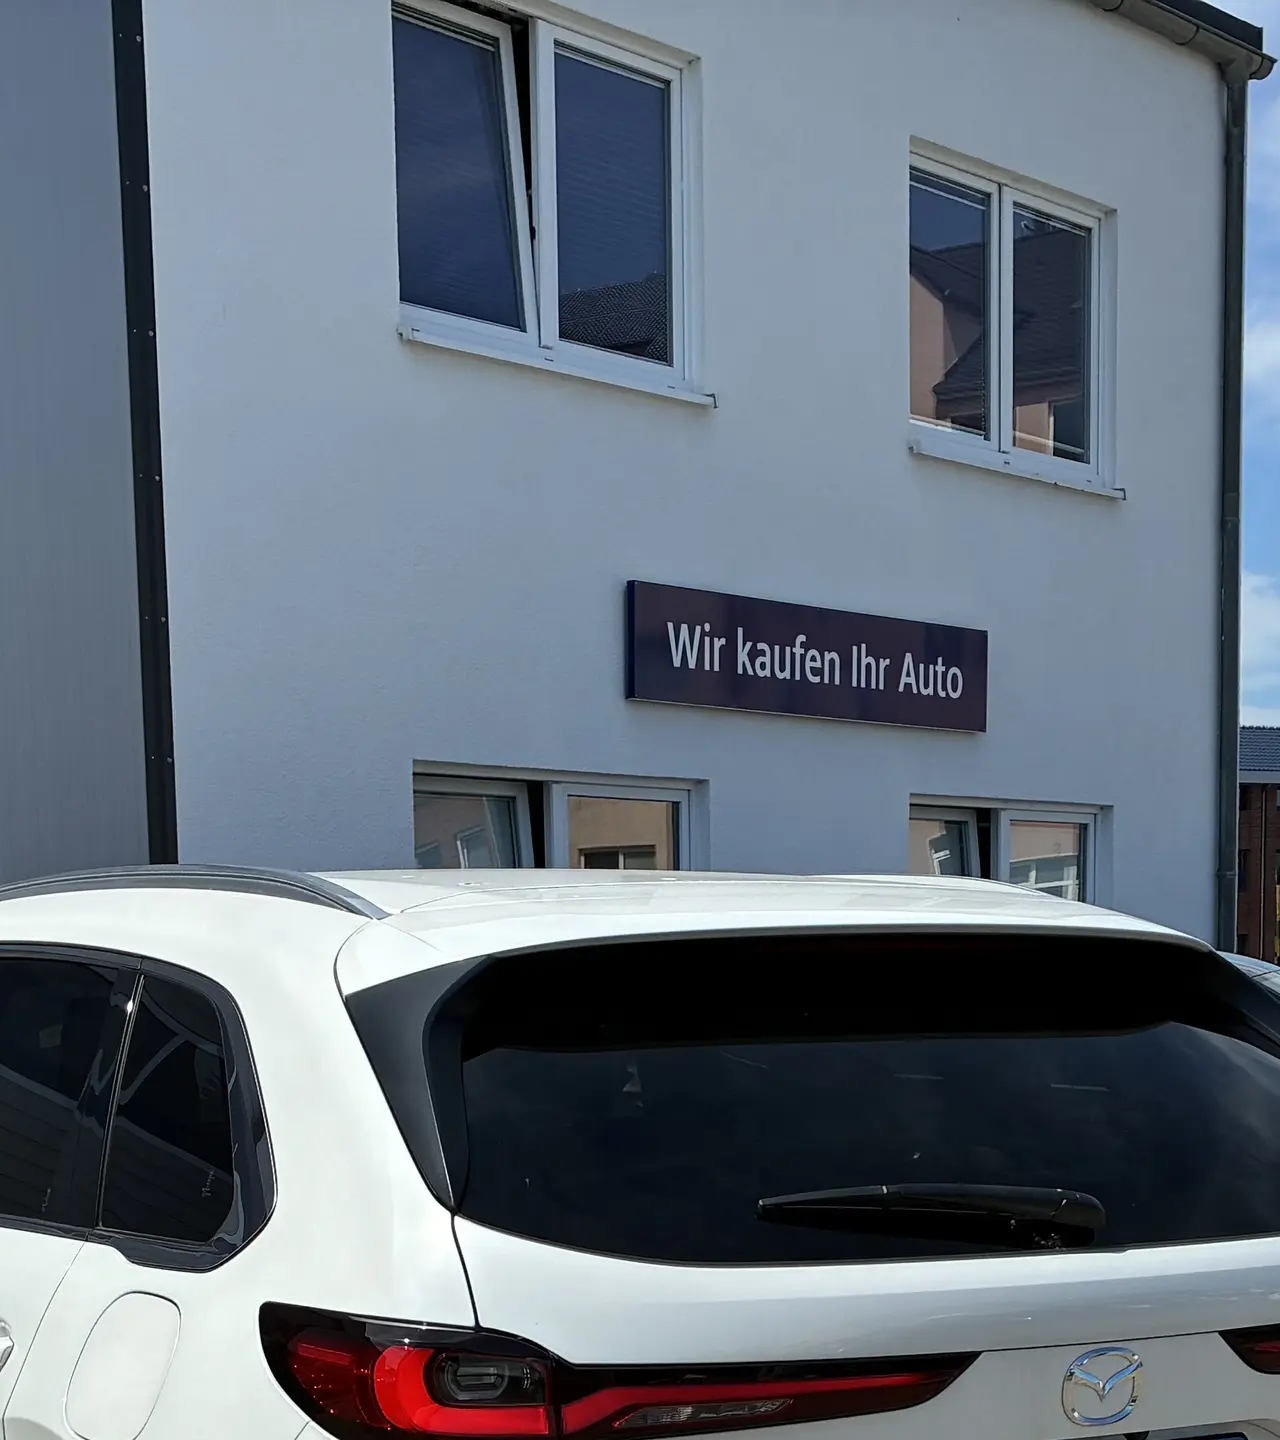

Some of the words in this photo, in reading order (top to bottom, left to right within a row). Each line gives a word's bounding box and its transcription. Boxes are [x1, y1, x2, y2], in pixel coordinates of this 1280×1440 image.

[666, 621, 726, 672] Wir
[737, 626, 840, 686] kaufen
[851, 643, 891, 691] Ihr
[898, 652, 963, 699] Auto
